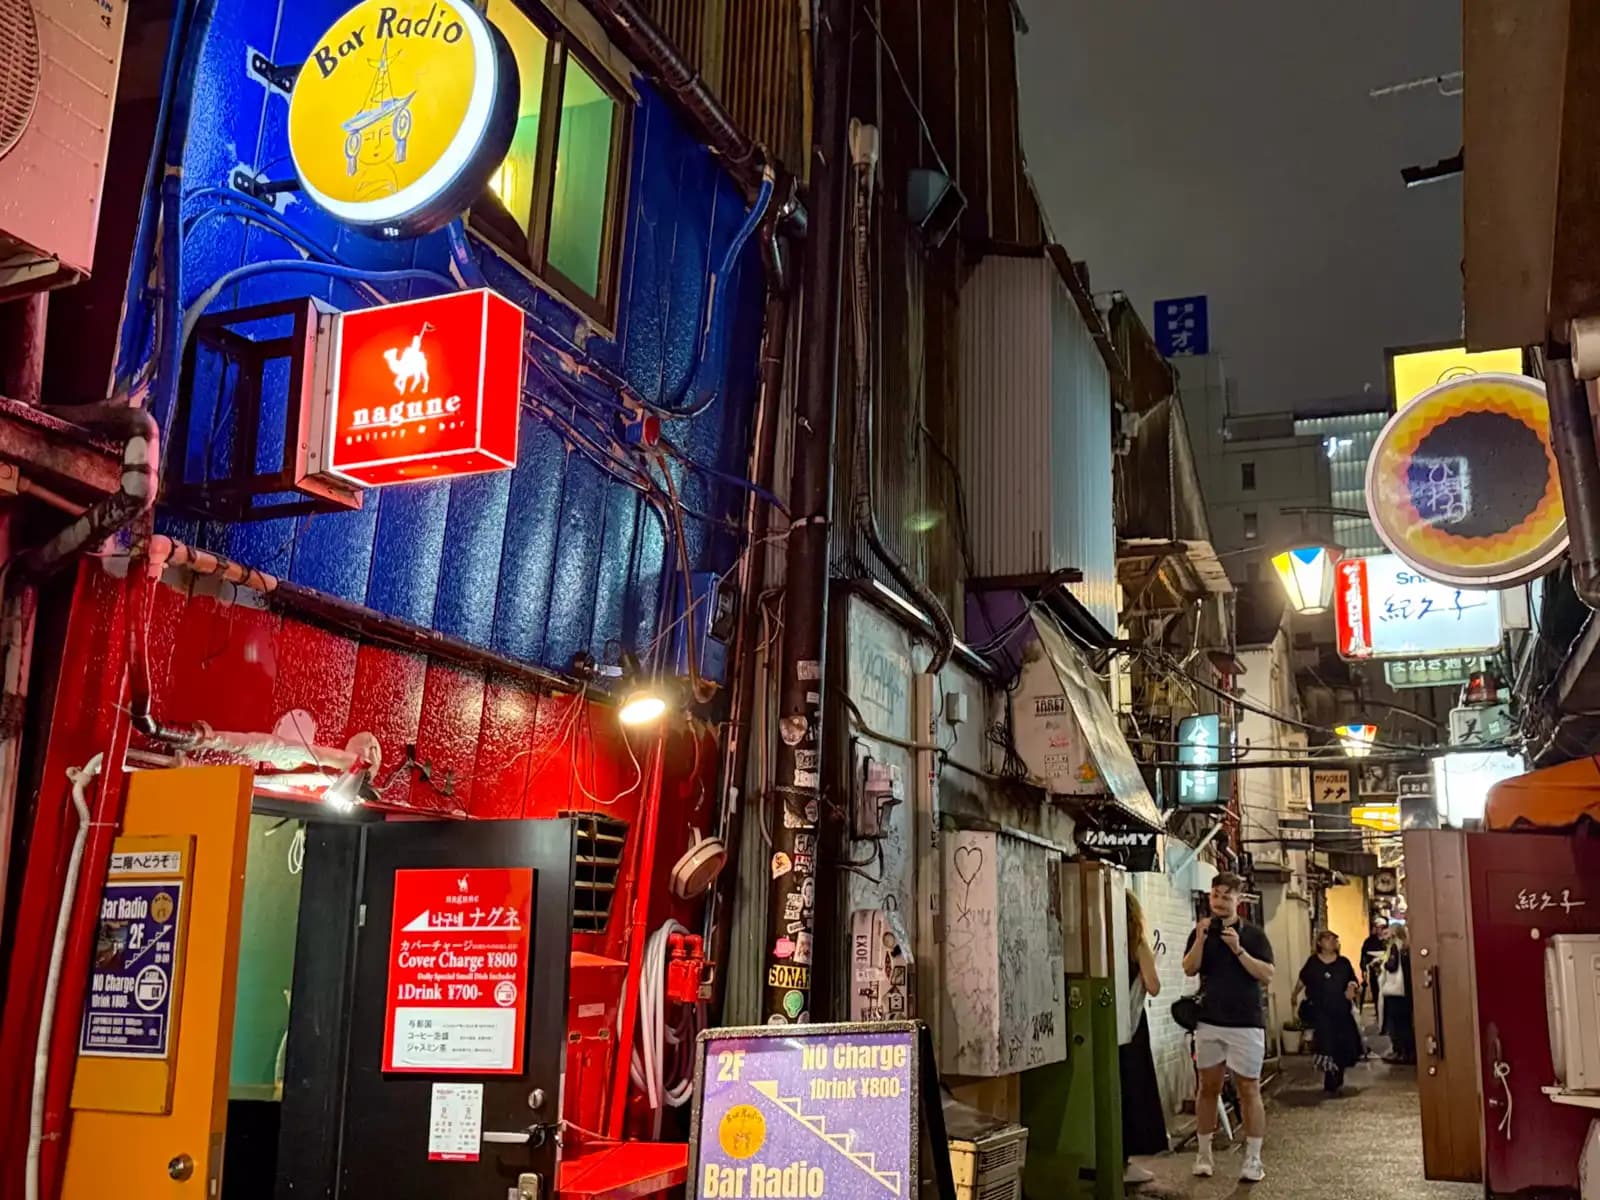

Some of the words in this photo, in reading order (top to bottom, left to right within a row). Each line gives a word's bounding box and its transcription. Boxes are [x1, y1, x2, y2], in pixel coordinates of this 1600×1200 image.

[313, 25, 366, 79] Bar
[376, 2, 463, 43] Radio
[352, 395, 461, 427] nagune
[110, 856, 170, 870] 二階へどうぞ
[118, 896, 148, 919] Radio
[469, 907, 520, 928] ナグネ
[128, 923, 145, 949] 2F
[400, 940, 473, 951] カバーチャージ
[398, 952, 436, 968] Cover
[438, 951, 484, 972] Charge
[487, 952, 518, 968] ¥800
[105, 974, 135, 994] Charge
[397, 984, 442, 1000] 1Drink
[448, 984, 483, 1000] ¥700-
[717, 1050, 746, 1081] 2F
[802, 1045, 828, 1070] NO
[833, 1043, 906, 1072] Charge
[811, 1078, 857, 1100] 1Drink
[703, 1163, 748, 1199] Bar
[751, 1160, 824, 1198] Radio
